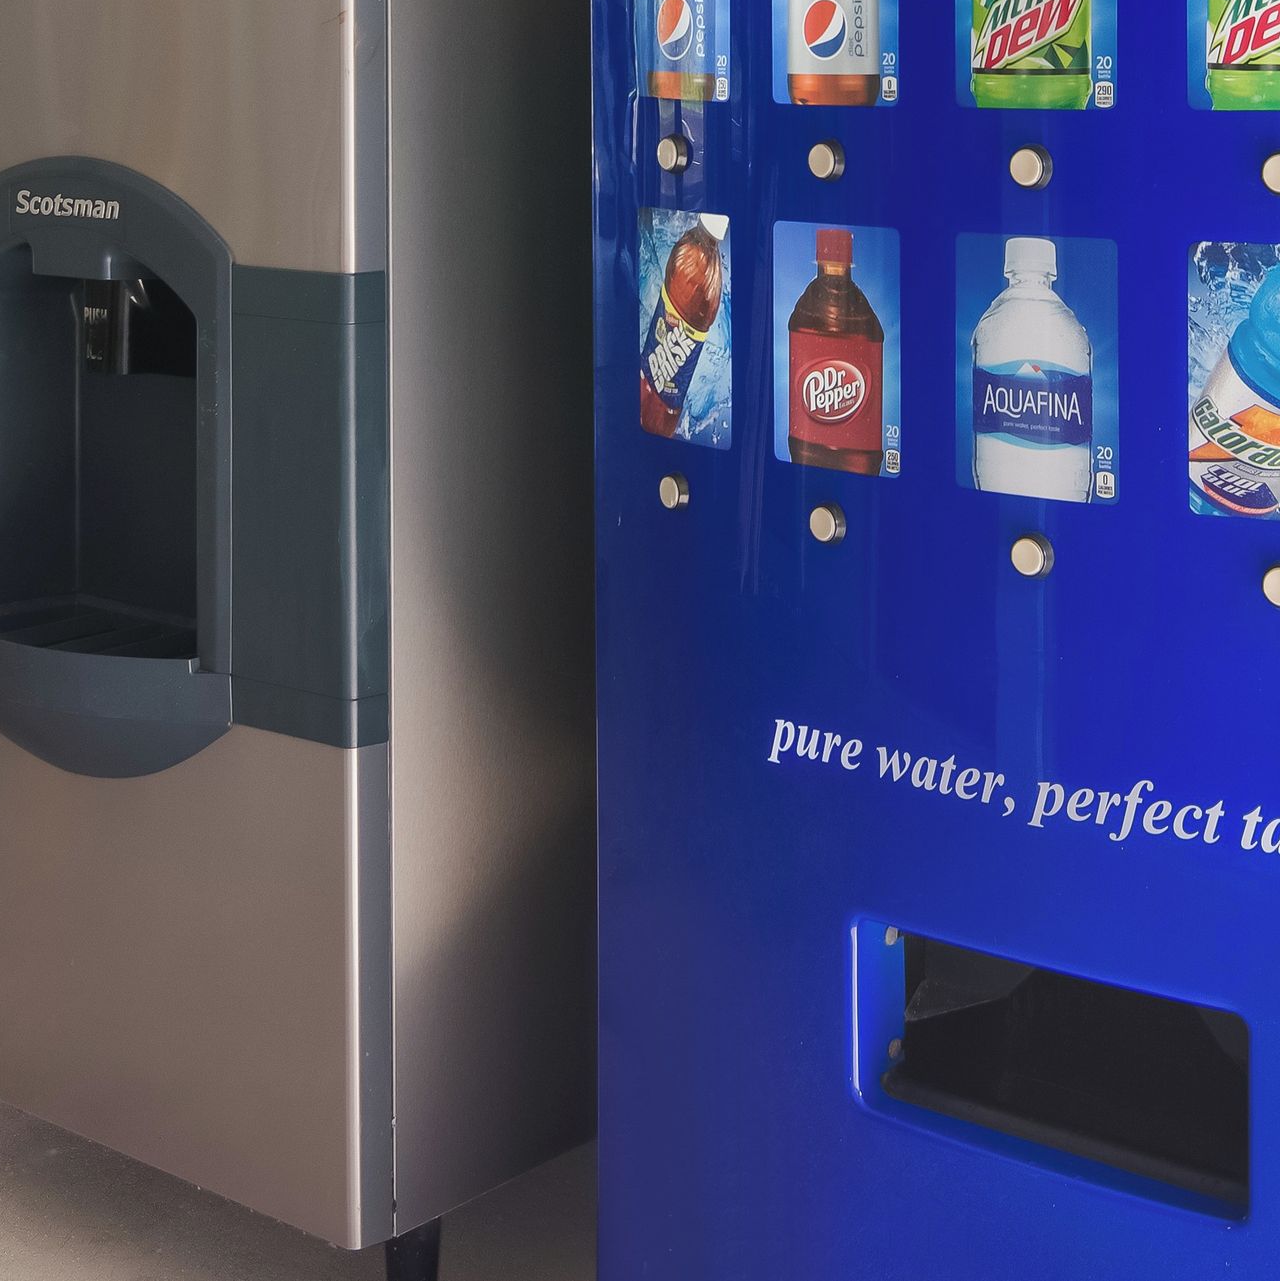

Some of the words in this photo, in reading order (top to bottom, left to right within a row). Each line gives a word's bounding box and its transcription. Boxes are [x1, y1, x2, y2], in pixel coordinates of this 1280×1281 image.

[694, 0, 706, 57] pepsi
[852, 0, 865, 57] pepsi
[716, 55, 727, 67] 20
[882, 52, 896, 66] 20
[1096, 55, 1112, 69] 20
[1096, 85, 1112, 96] 290
[15, 190, 120, 220] Scotsman
[648, 323, 697, 394] BRISK
[805, 370, 861, 413] Pepper
[823, 366, 846, 391] Dr
[983, 383, 1082, 425] AQUAFINA
[886, 424, 899, 438] 20
[1096, 445, 1113, 460] 20
[767, 719, 863, 771] pure
[876, 744, 1017, 817] water,
[1028, 779, 1224, 841] perfect
